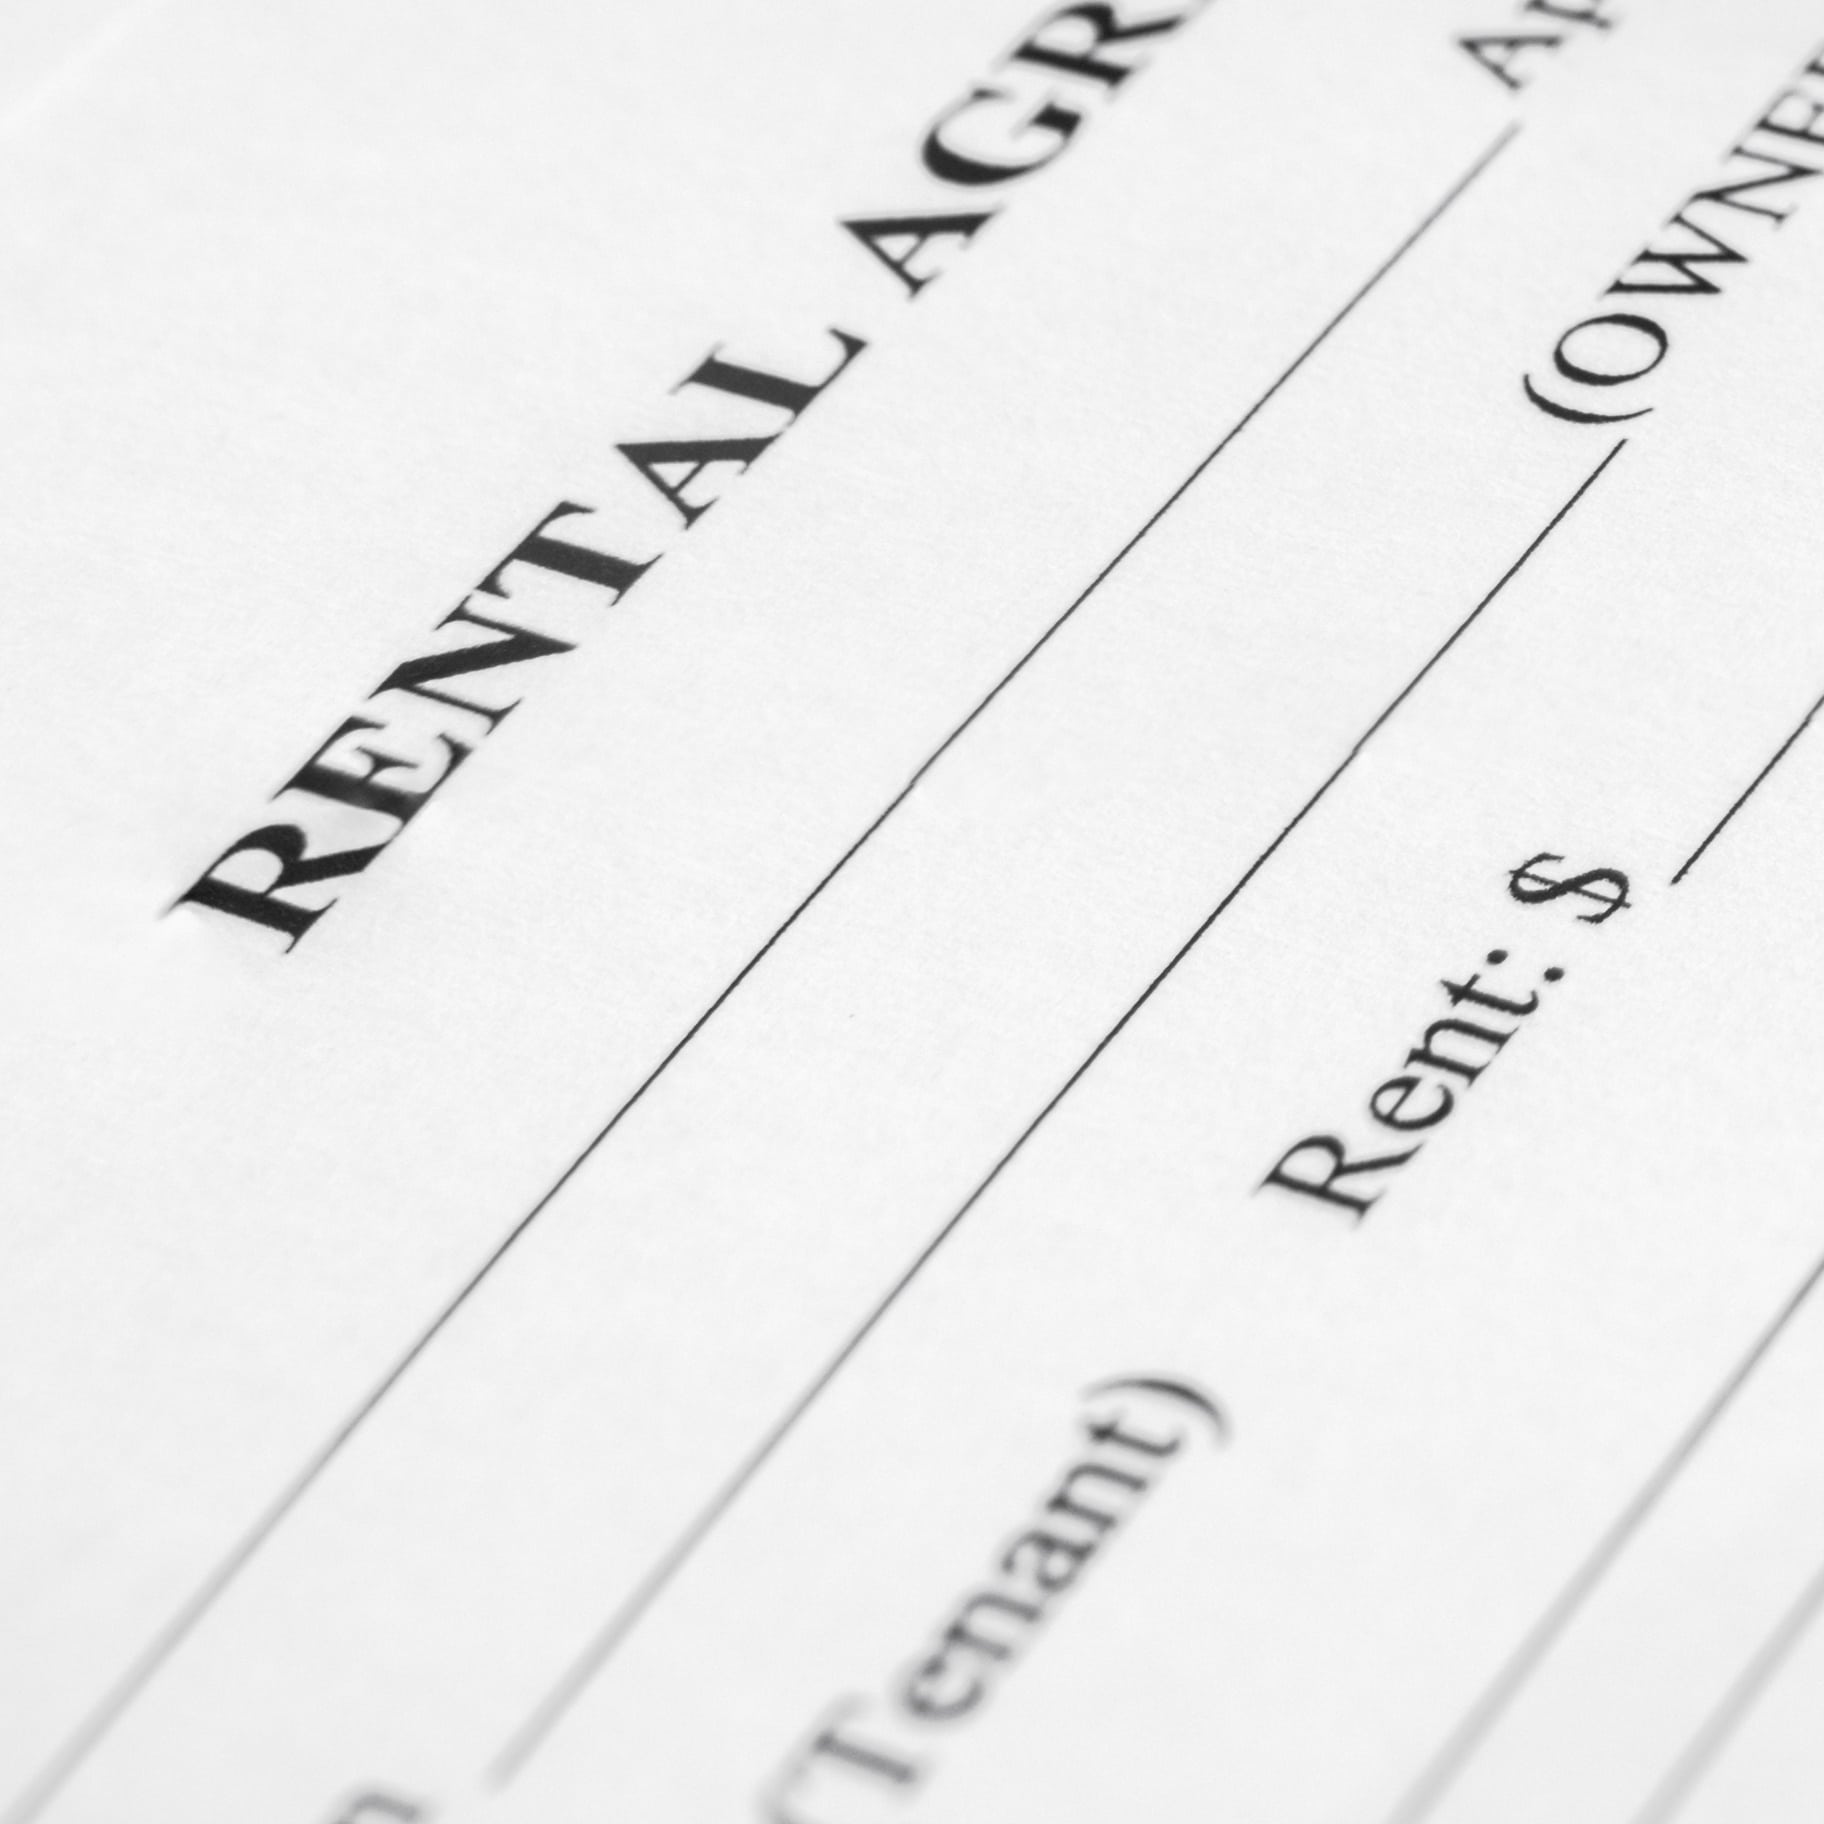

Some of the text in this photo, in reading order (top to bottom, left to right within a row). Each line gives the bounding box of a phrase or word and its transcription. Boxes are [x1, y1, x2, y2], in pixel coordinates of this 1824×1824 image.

[165, 326, 868, 953] RENTAL
[1252, 852, 1631, 1228] Rent: $
